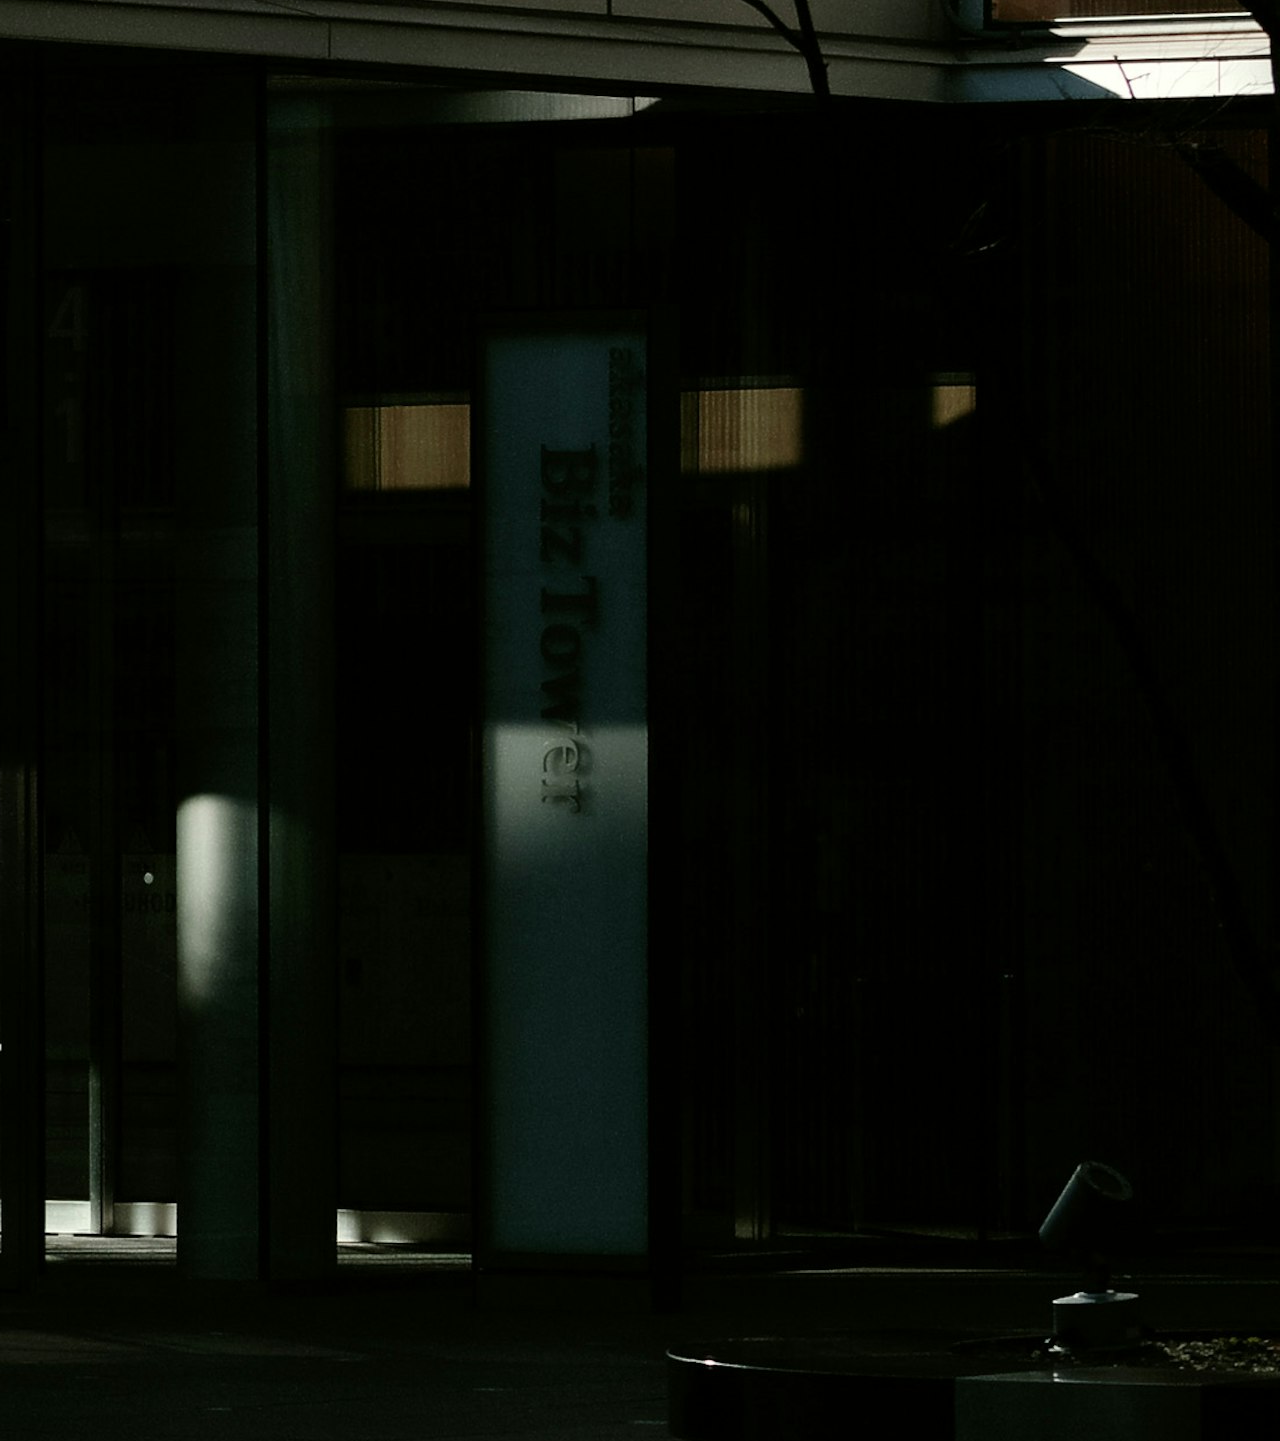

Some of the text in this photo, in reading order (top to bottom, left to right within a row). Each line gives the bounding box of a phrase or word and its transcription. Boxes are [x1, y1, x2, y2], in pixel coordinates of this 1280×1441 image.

[608, 346, 644, 517] akasaka
[539, 442, 598, 814] Biz Tower
